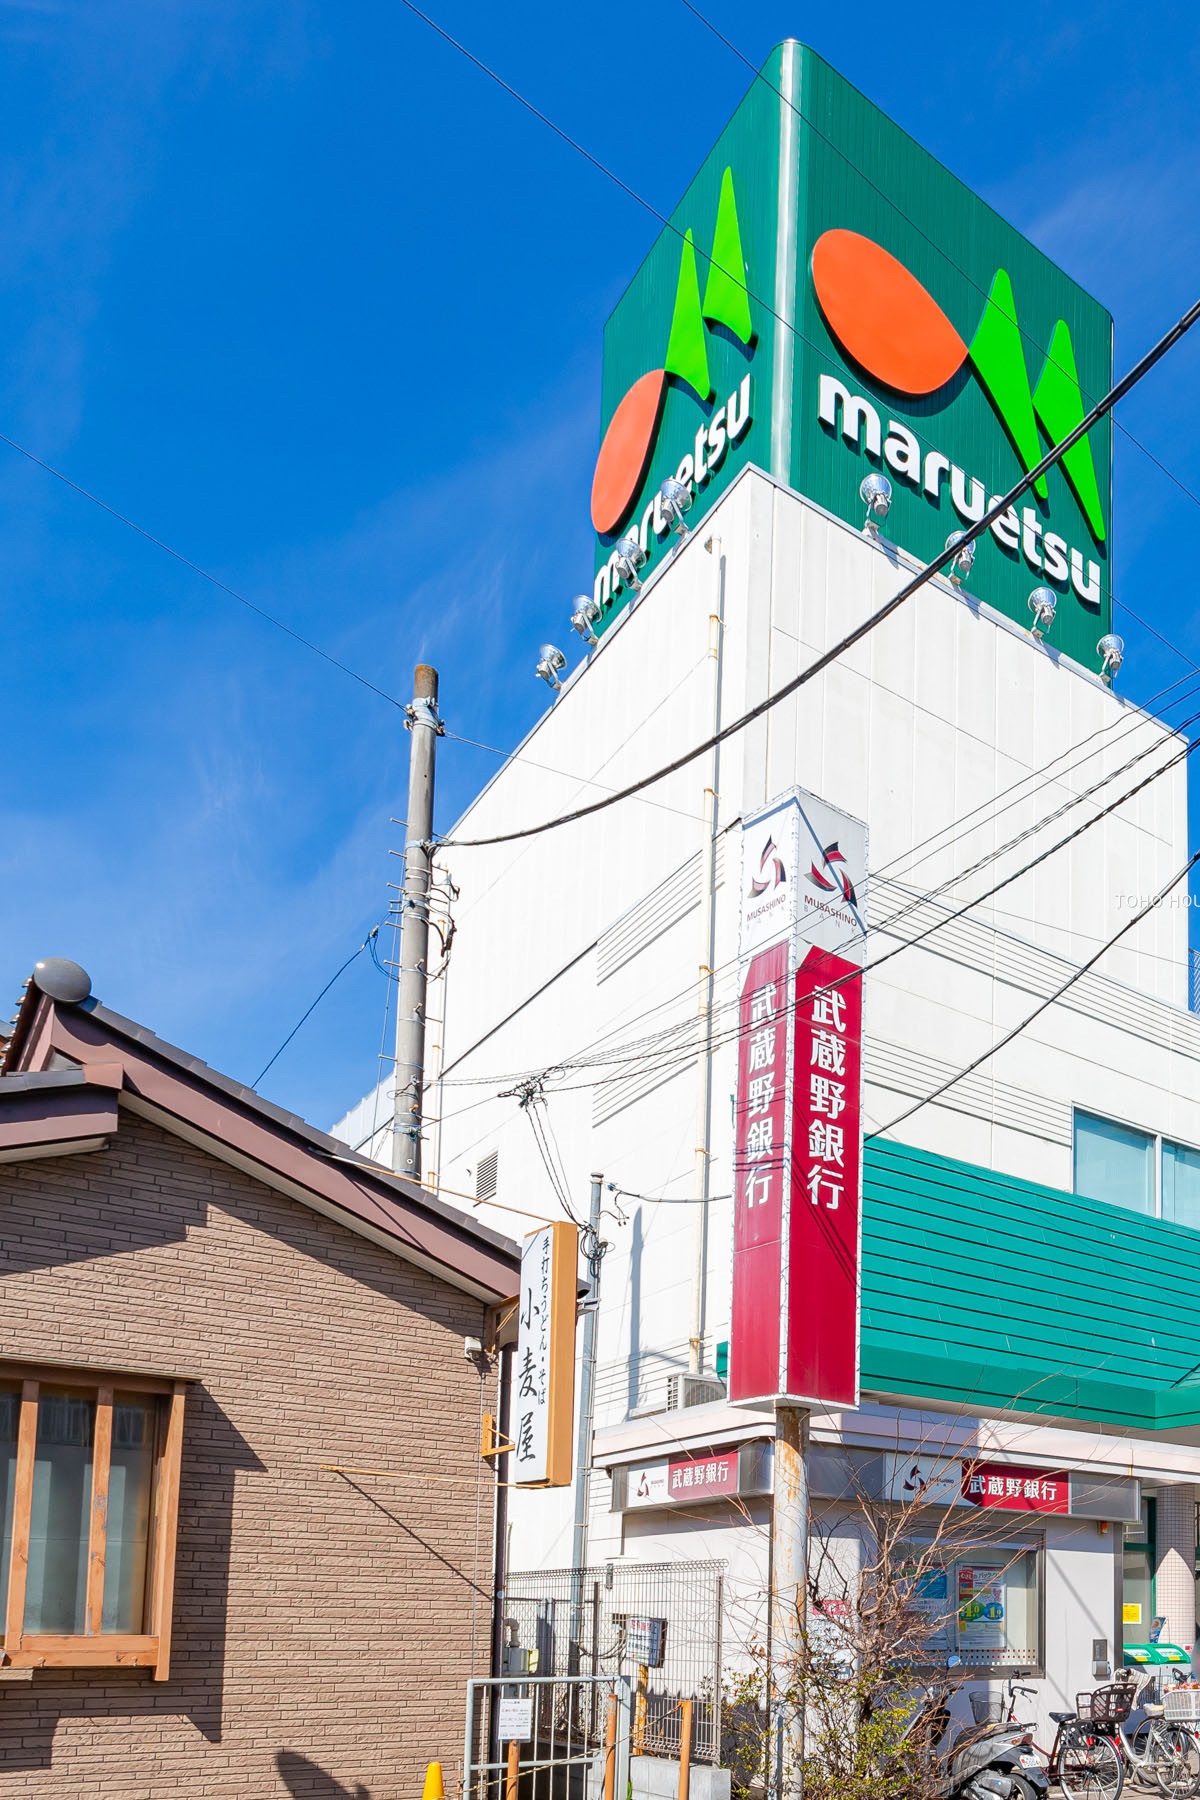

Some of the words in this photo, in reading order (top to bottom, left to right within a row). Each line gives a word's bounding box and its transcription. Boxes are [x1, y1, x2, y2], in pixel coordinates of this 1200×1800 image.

[818, 373, 1100, 604] maruetsu
[746, 894, 786, 922] MUSASHINO
[804, 895, 858, 927] MUSASHINO
[745, 983, 777, 1209] 武蔵野銀行
[807, 985, 847, 1210] 武蔵野銀行
[516, 1288, 540, 1462] 小麦屋
[672, 1461, 729, 1489] 武蔵野銀行
[969, 1474, 1058, 1501] 武蔵野銀行
